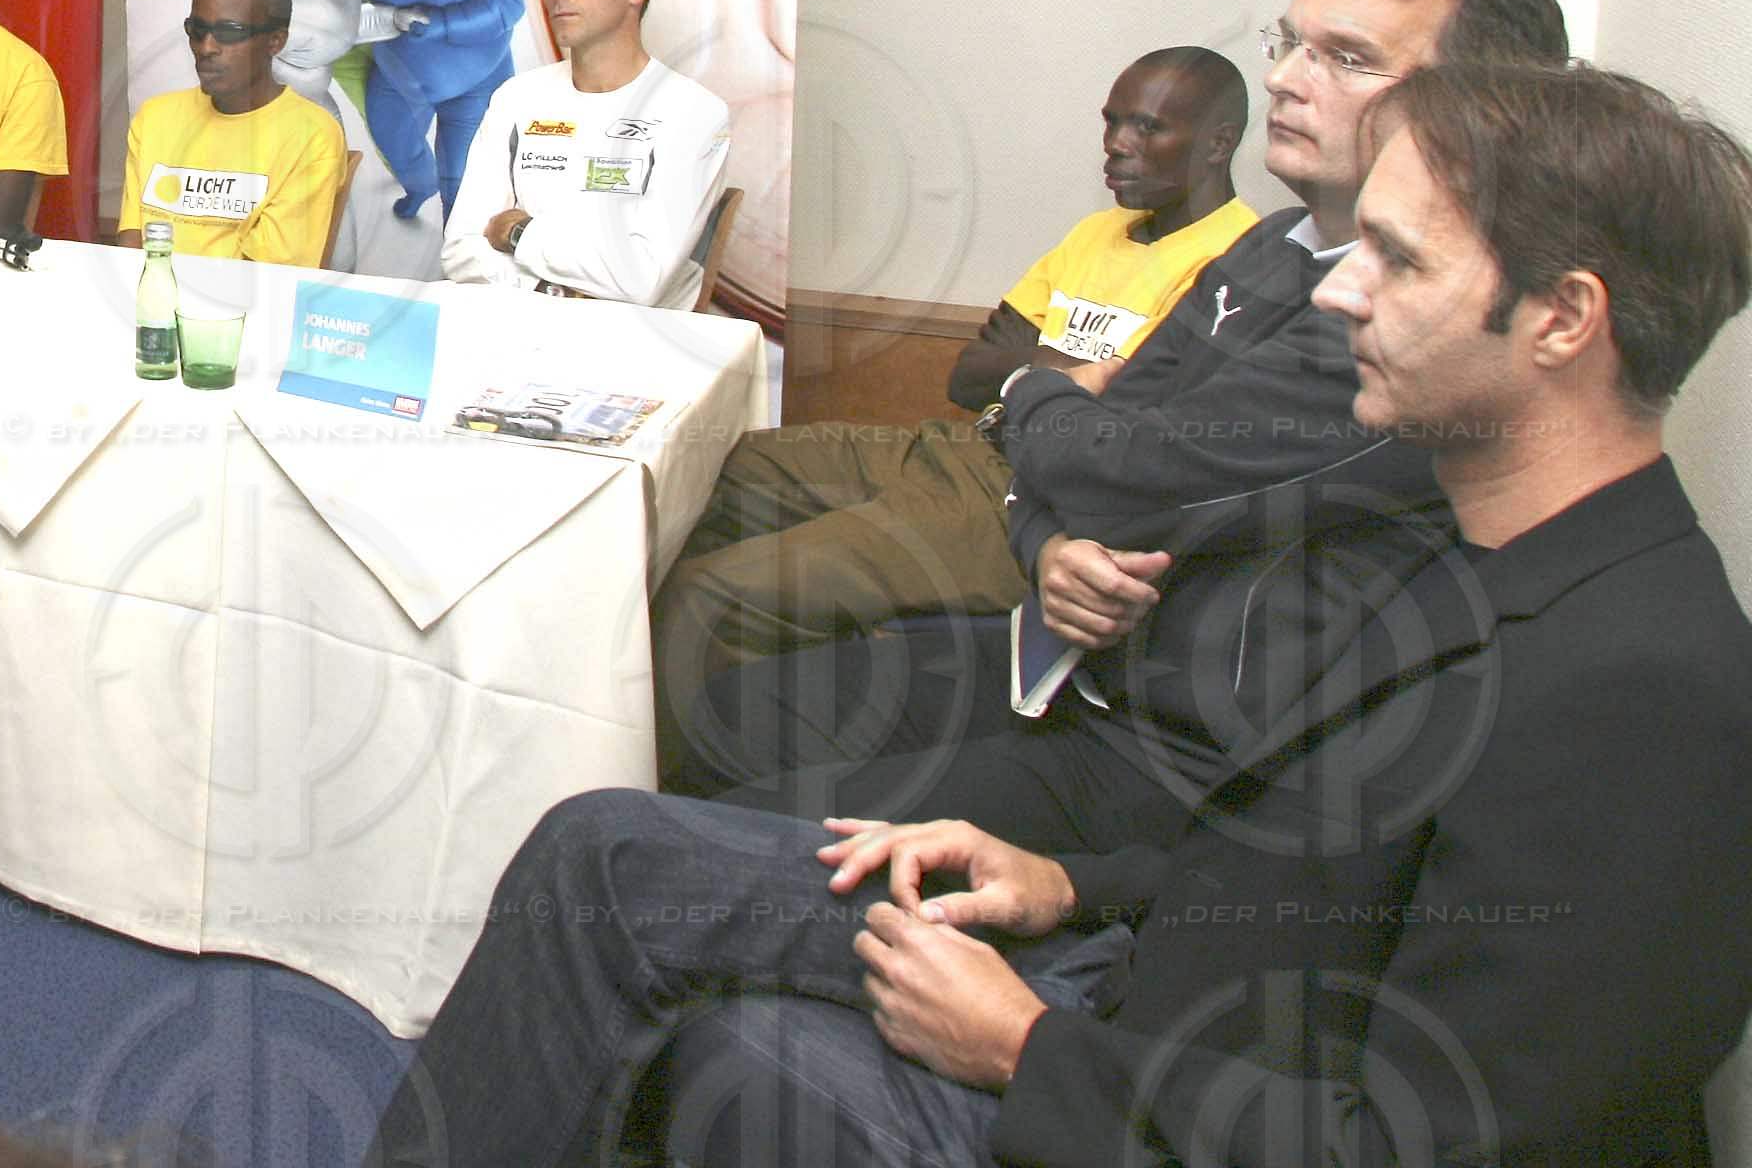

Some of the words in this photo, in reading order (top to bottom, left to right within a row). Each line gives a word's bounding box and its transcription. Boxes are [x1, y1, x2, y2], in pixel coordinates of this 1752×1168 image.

[185, 175, 236, 194] LICHT
[304, 313, 371, 336] JOHANNES
[302, 332, 367, 360] LANGER
